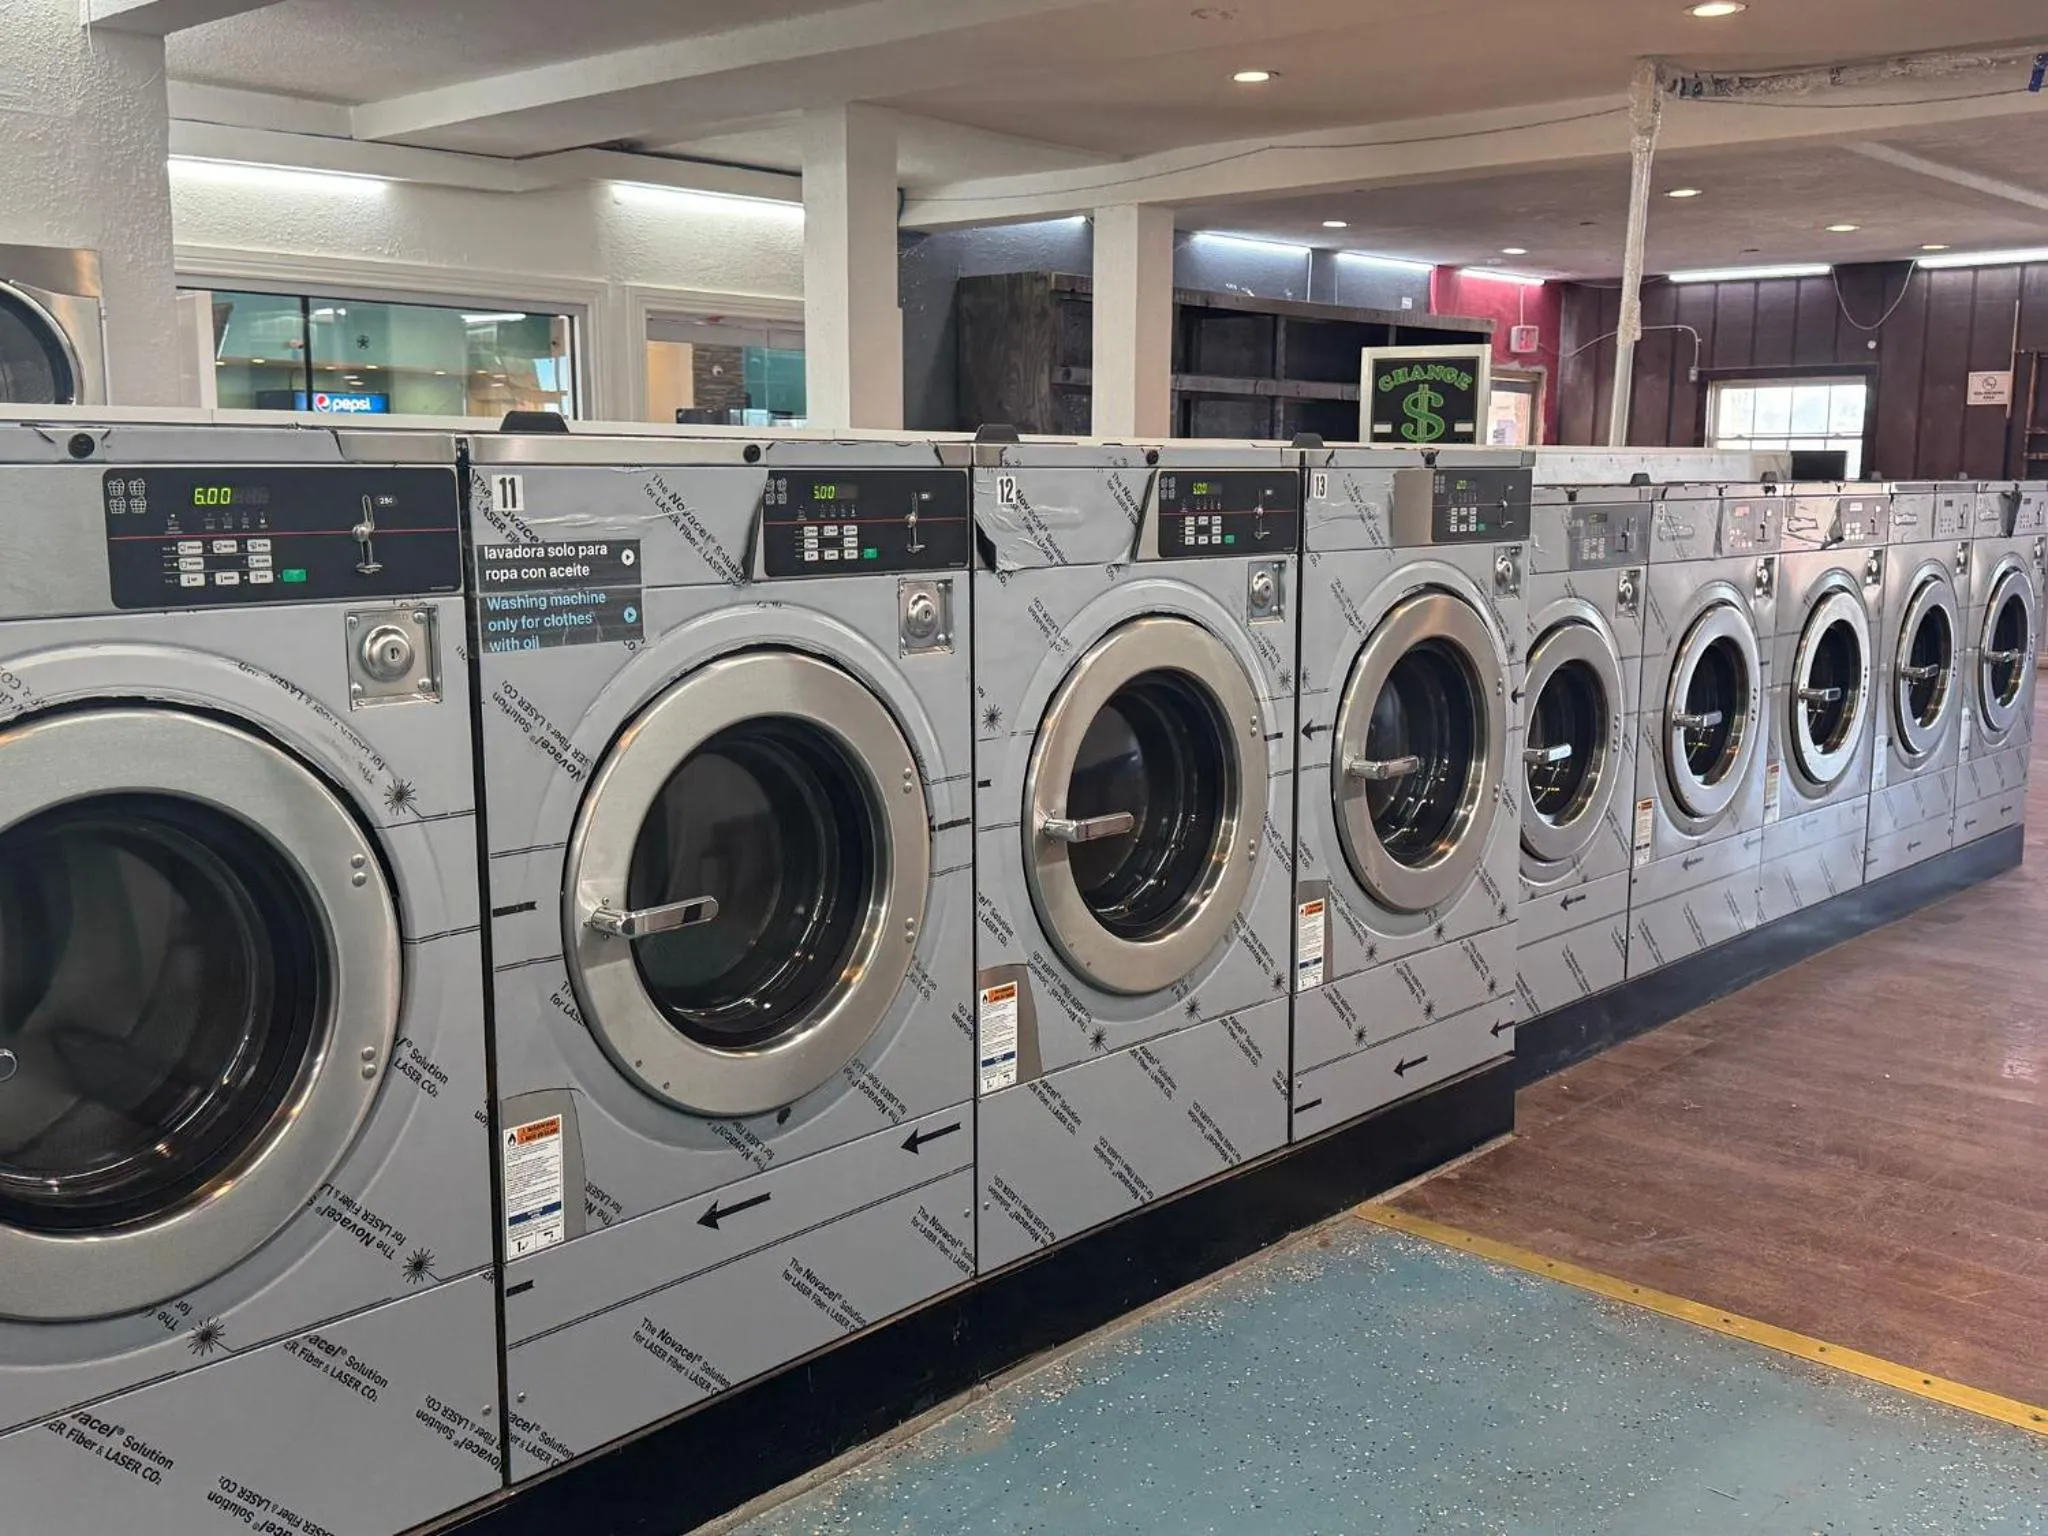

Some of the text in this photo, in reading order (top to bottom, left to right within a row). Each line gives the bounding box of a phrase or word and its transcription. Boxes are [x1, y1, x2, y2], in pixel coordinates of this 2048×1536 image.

[1379, 365, 1473, 391] CHANGE
[333, 397, 371, 412] pepsi
[500, 477, 516, 508] 11
[652, 472, 668, 494] The
[1000, 478, 1014, 502] 12
[1315, 475, 1325, 497] 13
[655, 496, 680, 526] LASER
[680, 524, 699, 547] Fiber
[702, 550, 727, 579] LASER
[484, 544, 608, 560] lavadora solo para
[485, 562, 590, 582] ropa con aceite
[486, 590, 606, 611] Washing machine
[488, 611, 593, 636] only for clothes
[490, 636, 539, 652] with oil
[492, 691, 532, 733] Solution
[518, 696, 546, 728] LASER
[550, 728, 571, 752] Fiber
[550, 993, 564, 1008] for
[394, 1058, 421, 1083] LASER
[411, 1048, 448, 1084] Solution
[586, 1182, 611, 1204] LASER
[362, 1210, 392, 1236] LASER
[376, 1240, 396, 1260] The
[392, 1230, 406, 1246] for
[789, 1256, 803, 1274] The
[174, 1300, 193, 1316] for
[158, 1310, 180, 1332] The
[641, 1316, 657, 1335] The
[298, 1346, 324, 1370] Fiber
[330, 1366, 362, 1392] LASER
[345, 1354, 388, 1388] Solution
[644, 1339, 668, 1360] LASER
[689, 1371, 712, 1392] LASER
[415, 1408, 456, 1441] Solution
[440, 1404, 470, 1430] LASER
[66, 1427, 97, 1455] Fiber
[104, 1448, 143, 1475] LASER
[123, 1434, 174, 1470] Solution
[525, 1441, 552, 1464] LASER
[207, 1490, 255, 1524] Solution
[237, 1486, 271, 1512] LASER
[276, 1508, 303, 1529] Fiber
